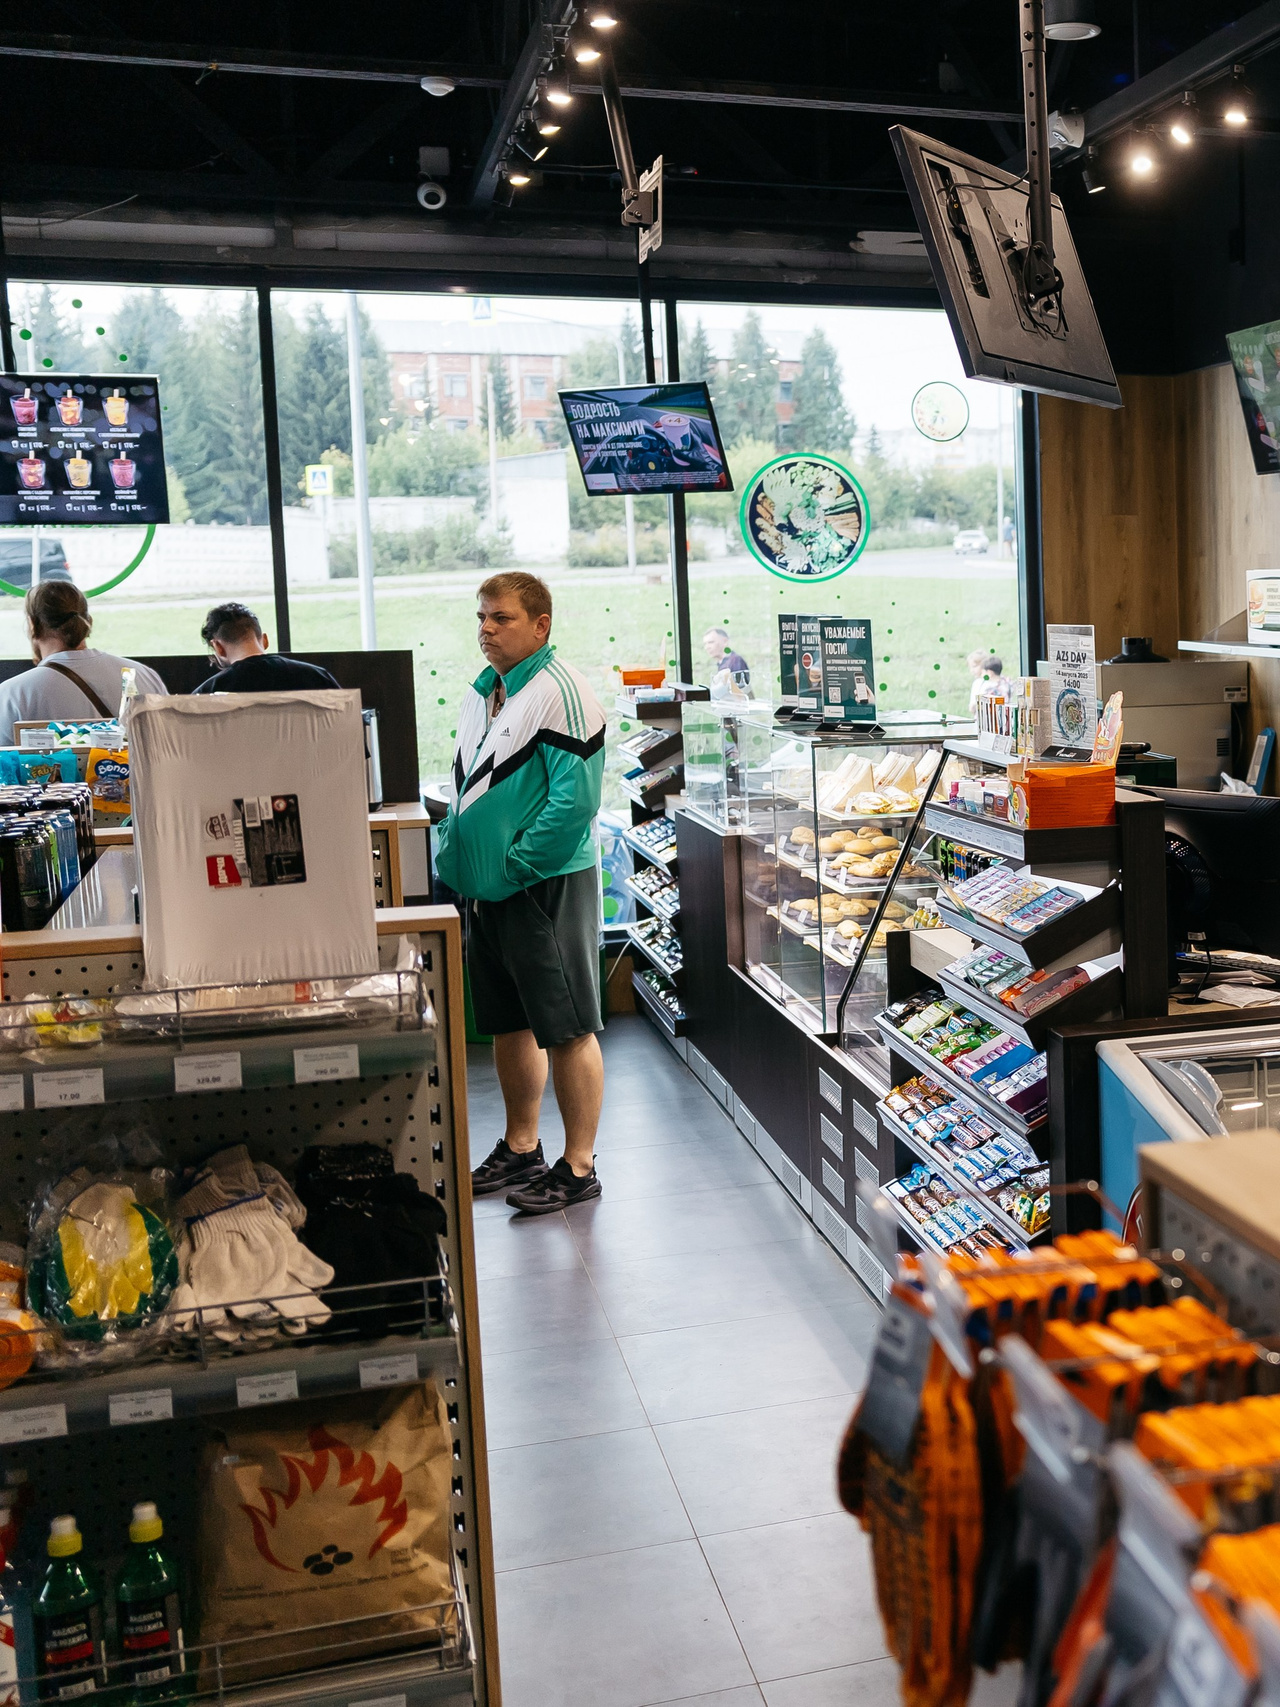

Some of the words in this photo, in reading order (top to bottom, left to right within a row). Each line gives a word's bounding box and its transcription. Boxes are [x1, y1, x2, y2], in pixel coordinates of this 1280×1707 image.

[570, 402, 620, 420] БОДРОСТЬ
[576, 424, 590, 438] НА
[592, 421, 646, 438] МАКСИМУМ
[824, 627, 866, 639] УВАЖАЕМЫЕ
[825, 643, 848, 655] ГОСТИ!
[1056, 650, 1069, 662] AZS
[1070, 652, 1087, 664] DAY
[1063, 679, 1081, 689] 14:00
